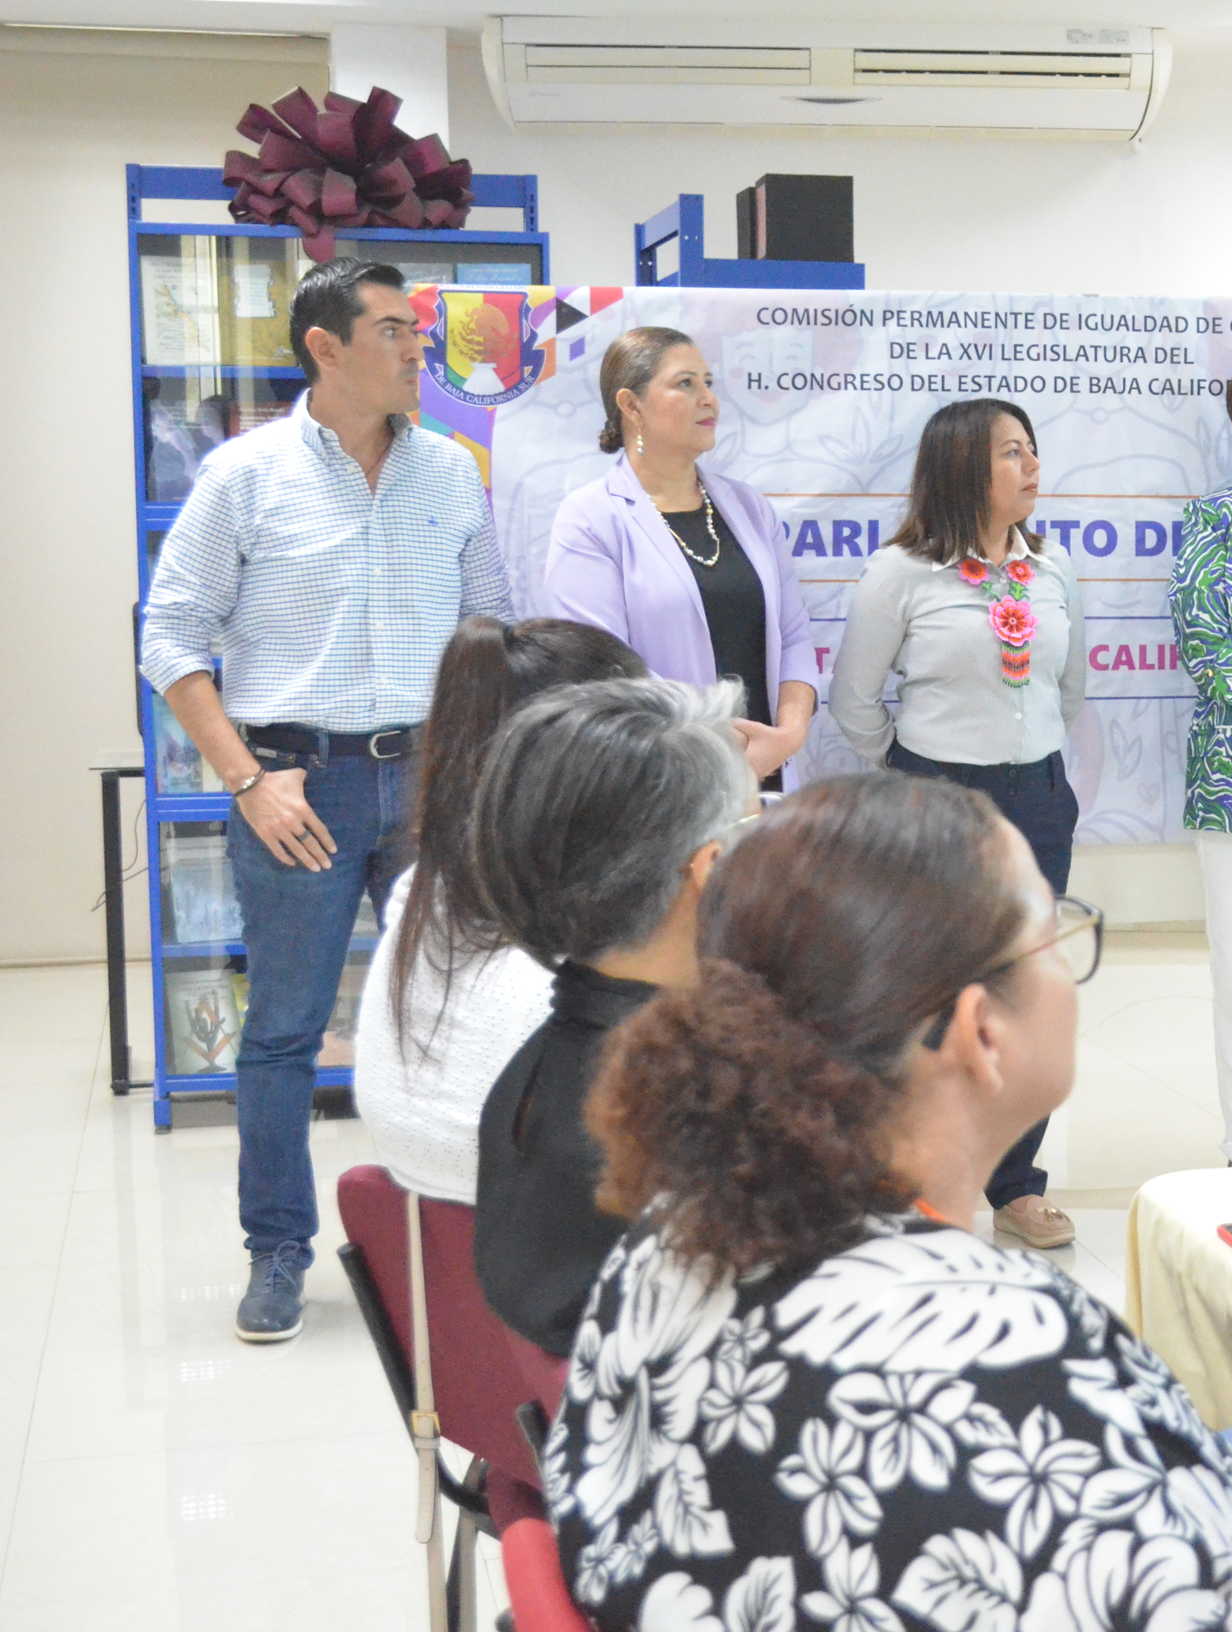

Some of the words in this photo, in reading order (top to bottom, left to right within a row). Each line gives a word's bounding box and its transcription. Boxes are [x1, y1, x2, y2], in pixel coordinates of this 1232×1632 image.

[756, 304, 874, 327] COMISIÓN
[882, 310, 1036, 330] PERMANENTE
[1043, 312, 1070, 330] DE
[1078, 313, 1189, 333] IGUALDAD
[1196, 316, 1223, 334] DE
[889, 342, 917, 360] DE
[925, 342, 952, 361] LA
[958, 343, 993, 361] XVI
[1001, 343, 1148, 364] LEGISLATURA
[1154, 347, 1195, 365] DEL
[747, 372, 769, 390] H.
[776, 372, 904, 391] CONGRESO
[910, 374, 951, 392] DEL
[958, 375, 1046, 393] ESTADO
[1054, 376, 1081, 394] DE
[1089, 376, 1142, 395] BAJA
[1148, 378, 1231, 396] CALIFO
